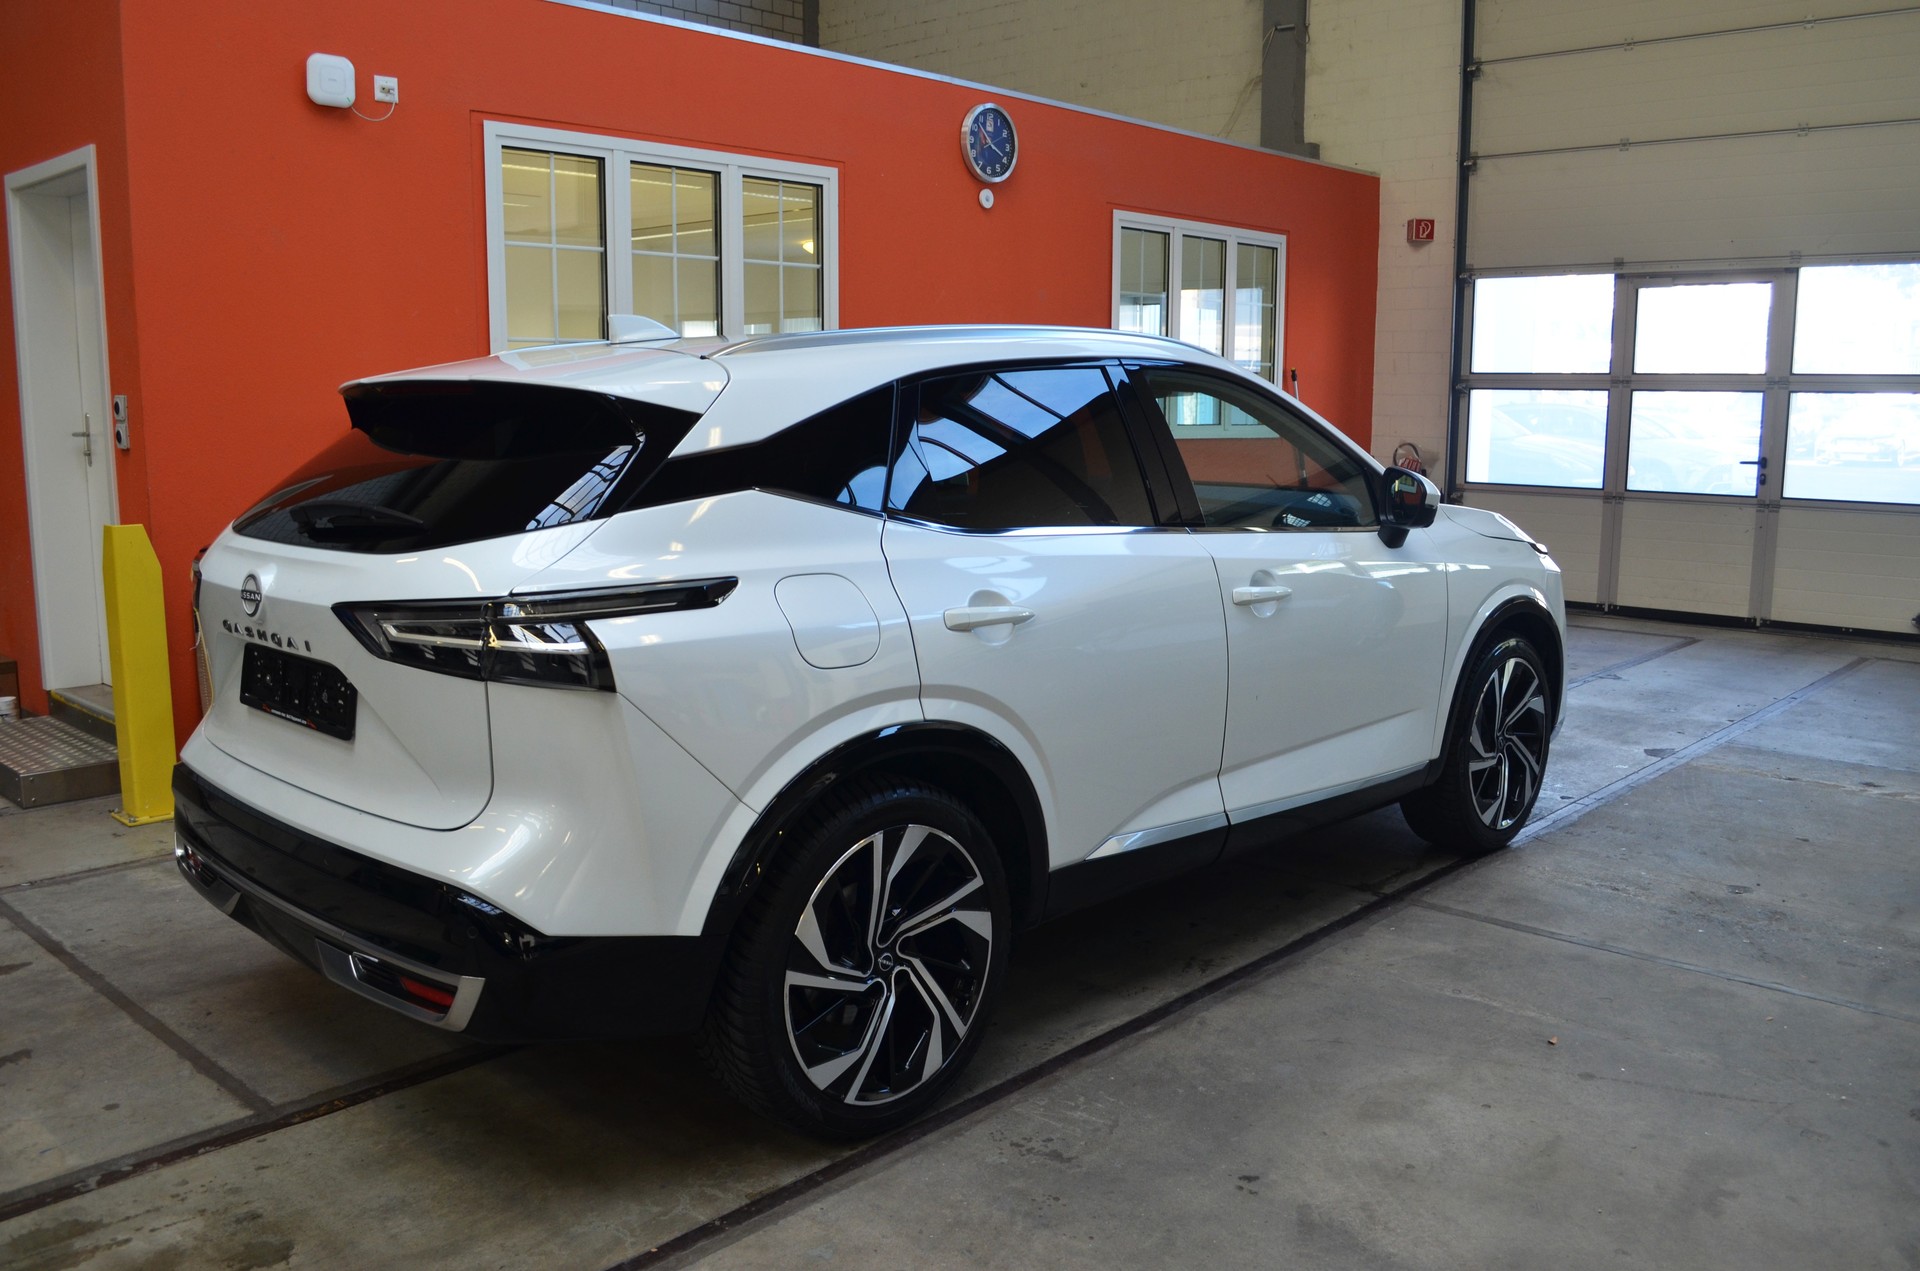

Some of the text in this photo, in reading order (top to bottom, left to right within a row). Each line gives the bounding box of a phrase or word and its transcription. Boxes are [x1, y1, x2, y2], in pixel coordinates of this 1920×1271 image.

[971, 124, 978, 132] 10
[1002, 130, 1007, 138] 2
[1005, 143, 1010, 152] 3
[1002, 156, 1007, 164] 4
[978, 161, 983, 169] 7
[995, 164, 1000, 172] 5
[986, 166, 992, 175] 6
[222, 619, 312, 652] QASHQAI
